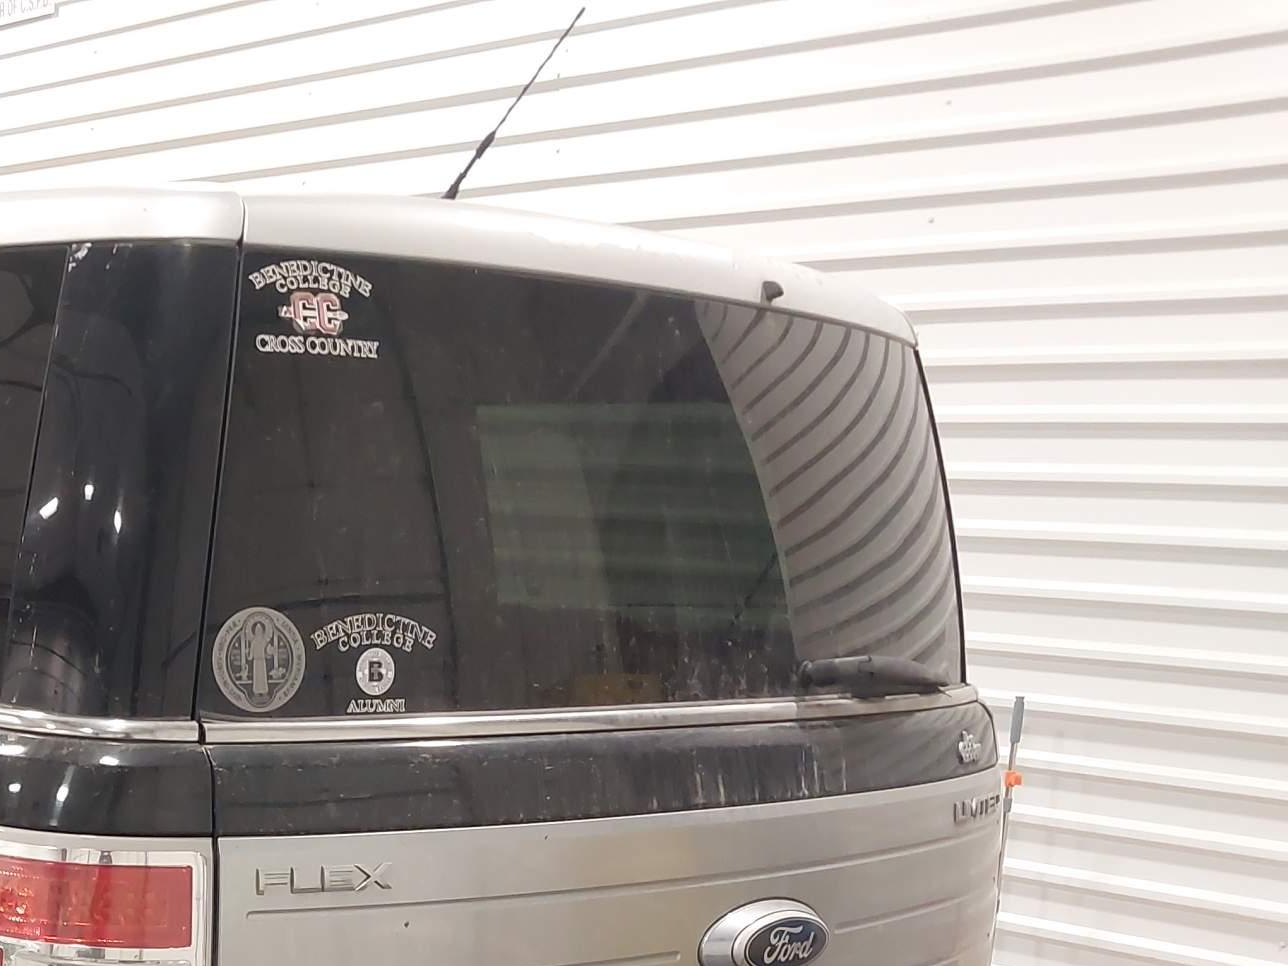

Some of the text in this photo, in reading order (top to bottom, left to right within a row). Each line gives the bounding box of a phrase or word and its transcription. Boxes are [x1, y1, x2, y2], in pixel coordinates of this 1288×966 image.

[248, 260, 372, 298] BENEDICTINE
[275, 275, 351, 298] COLLEGE
[255, 334, 379, 359] CROSS COUNTRY
[310, 613, 437, 650] BENEDICTINE
[337, 629, 415, 653] COLLEGE
[346, 698, 406, 713] ALUMNI
[254, 862, 393, 896] FLEX
[762, 925, 815, 965] Ford
